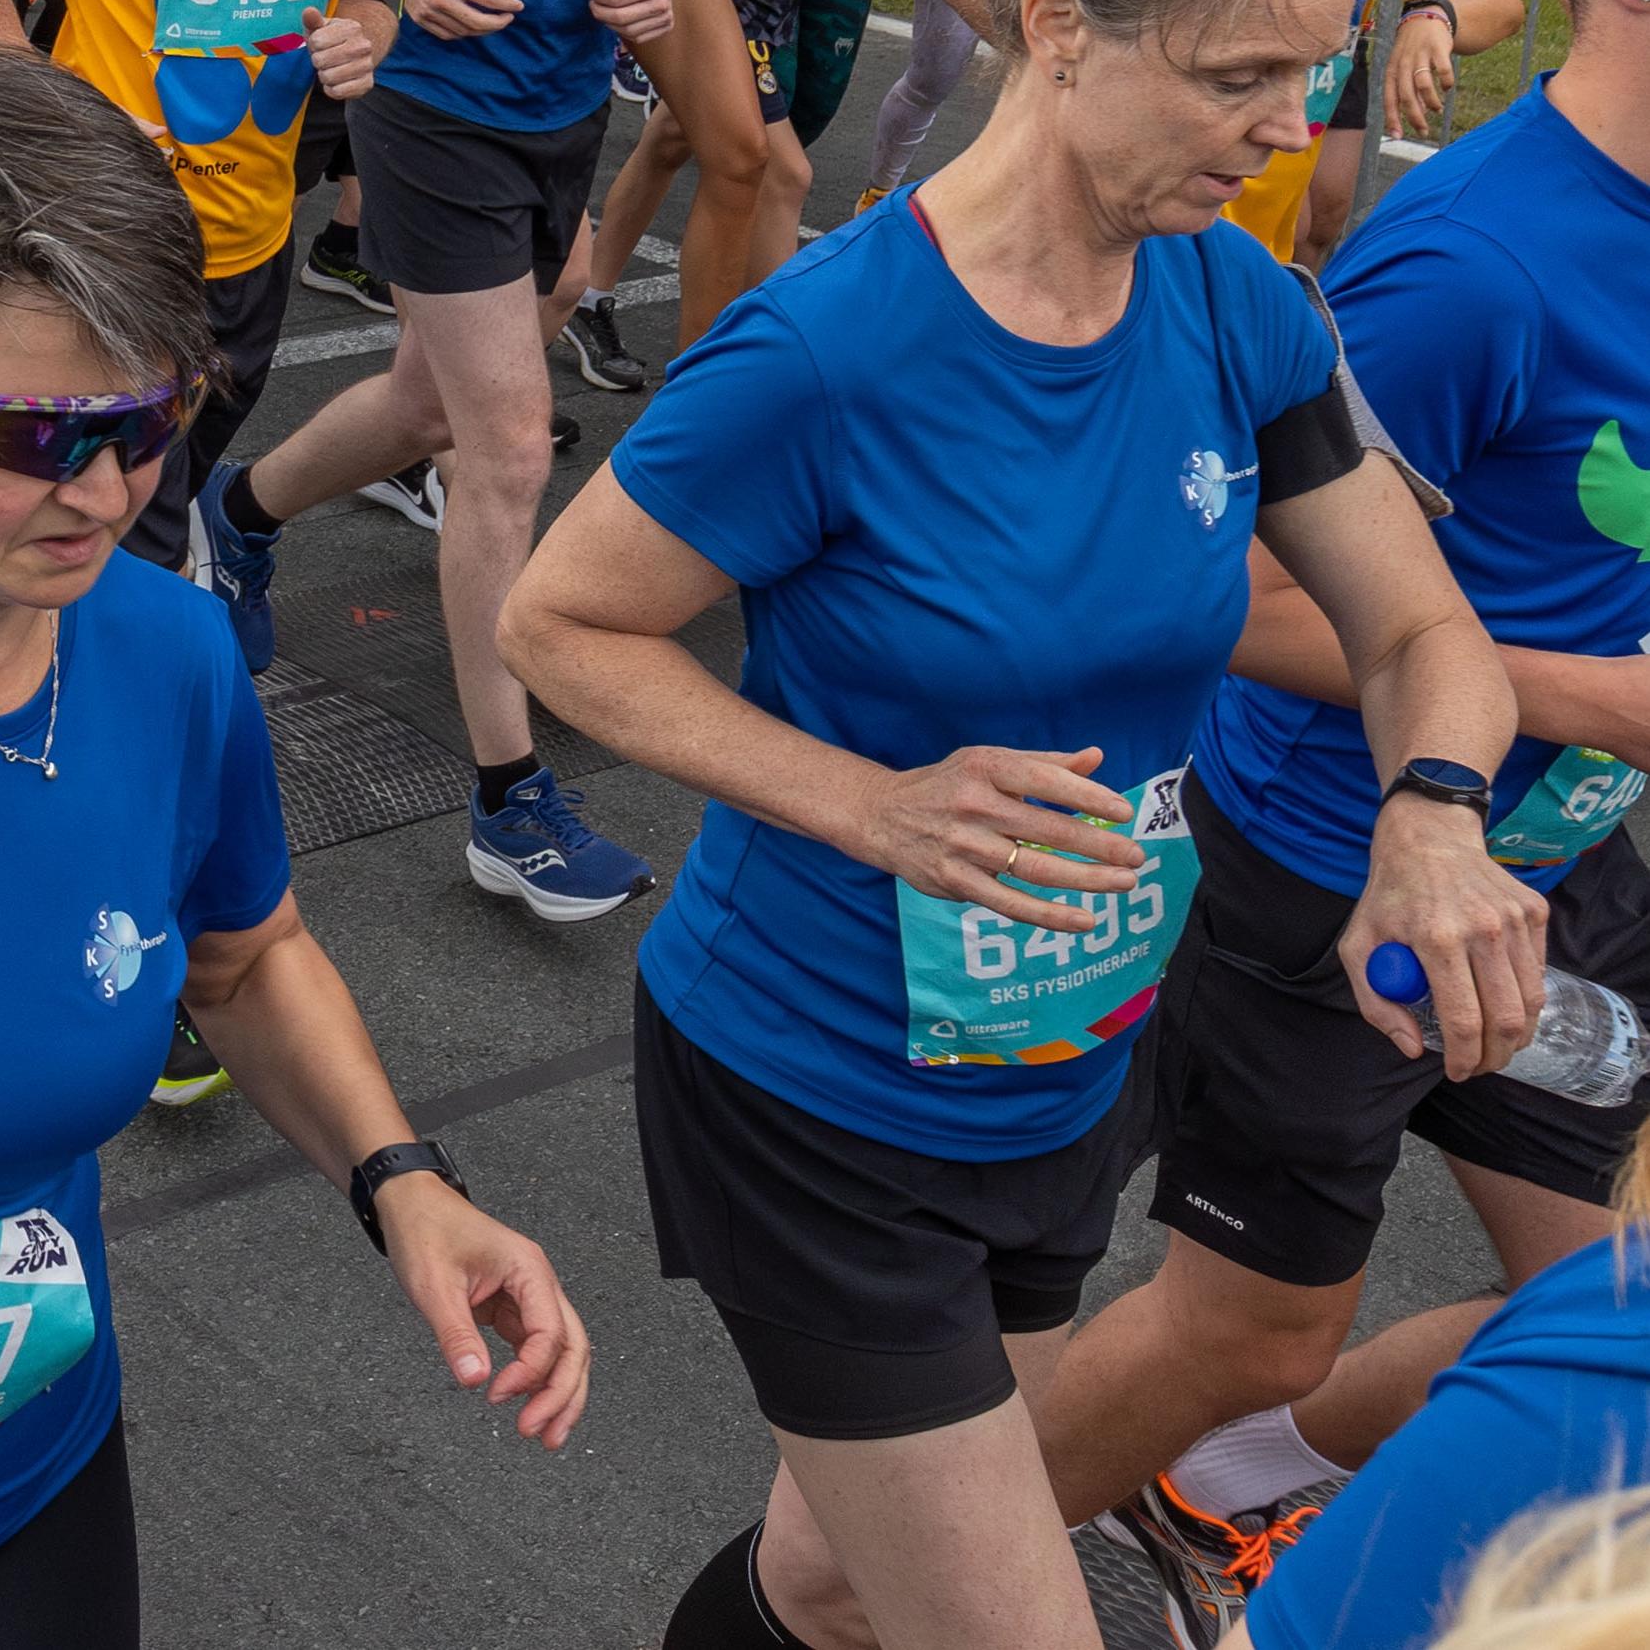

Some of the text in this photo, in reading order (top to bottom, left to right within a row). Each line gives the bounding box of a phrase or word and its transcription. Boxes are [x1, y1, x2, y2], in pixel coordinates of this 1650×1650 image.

[232, 8, 273, 20] PIENTER
[990, 940, 1151, 1005] SKS FYSIOTHERAPIE
[965, 1017, 1031, 1036] Ultraware
[1185, 1193, 1245, 1231] ARTENGO
[5, 1246, 68, 1277] RUN
